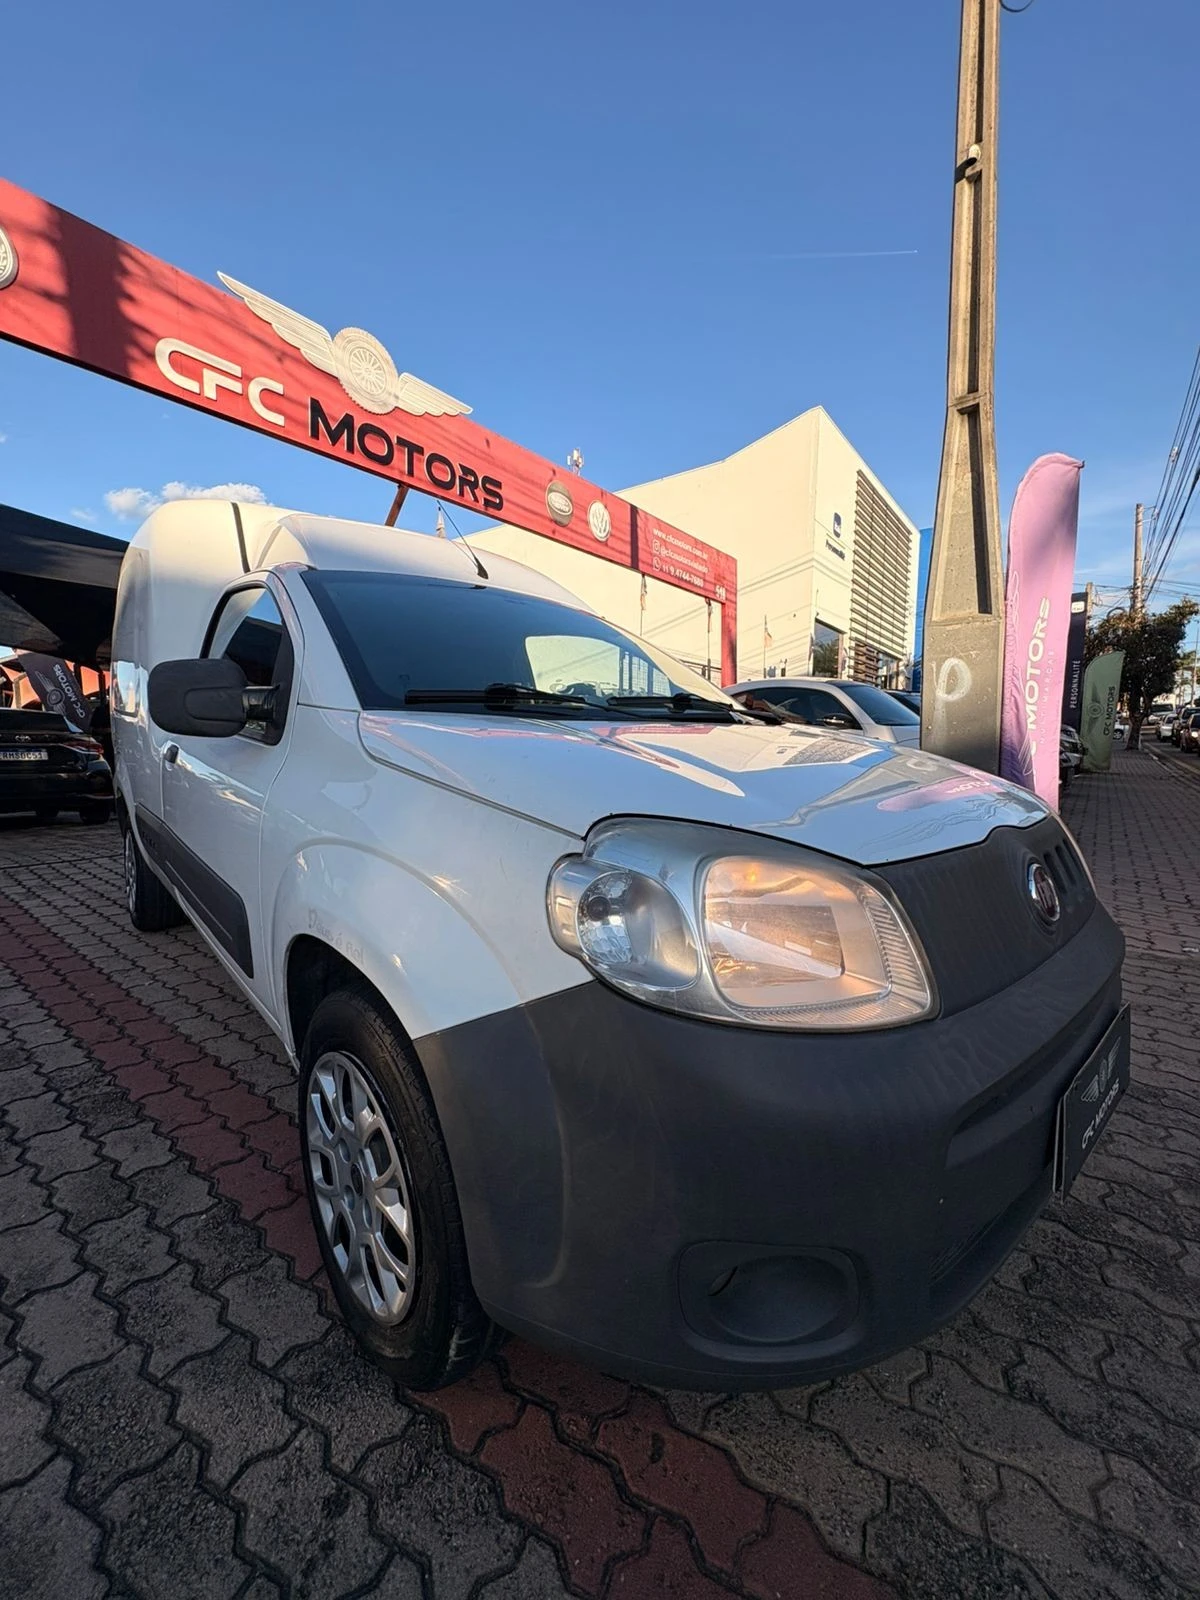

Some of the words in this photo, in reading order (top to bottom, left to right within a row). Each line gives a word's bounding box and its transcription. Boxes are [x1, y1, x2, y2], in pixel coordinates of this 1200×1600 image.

[154, 337, 286, 427] CFC
[308, 396, 505, 512] MOTORS
[52, 663, 78, 702] MOTORS
[1024, 597, 1050, 730] MOTORS
[1105, 685, 1116, 720] MOTORS
[1094, 1077, 1120, 1129] MOTORS
